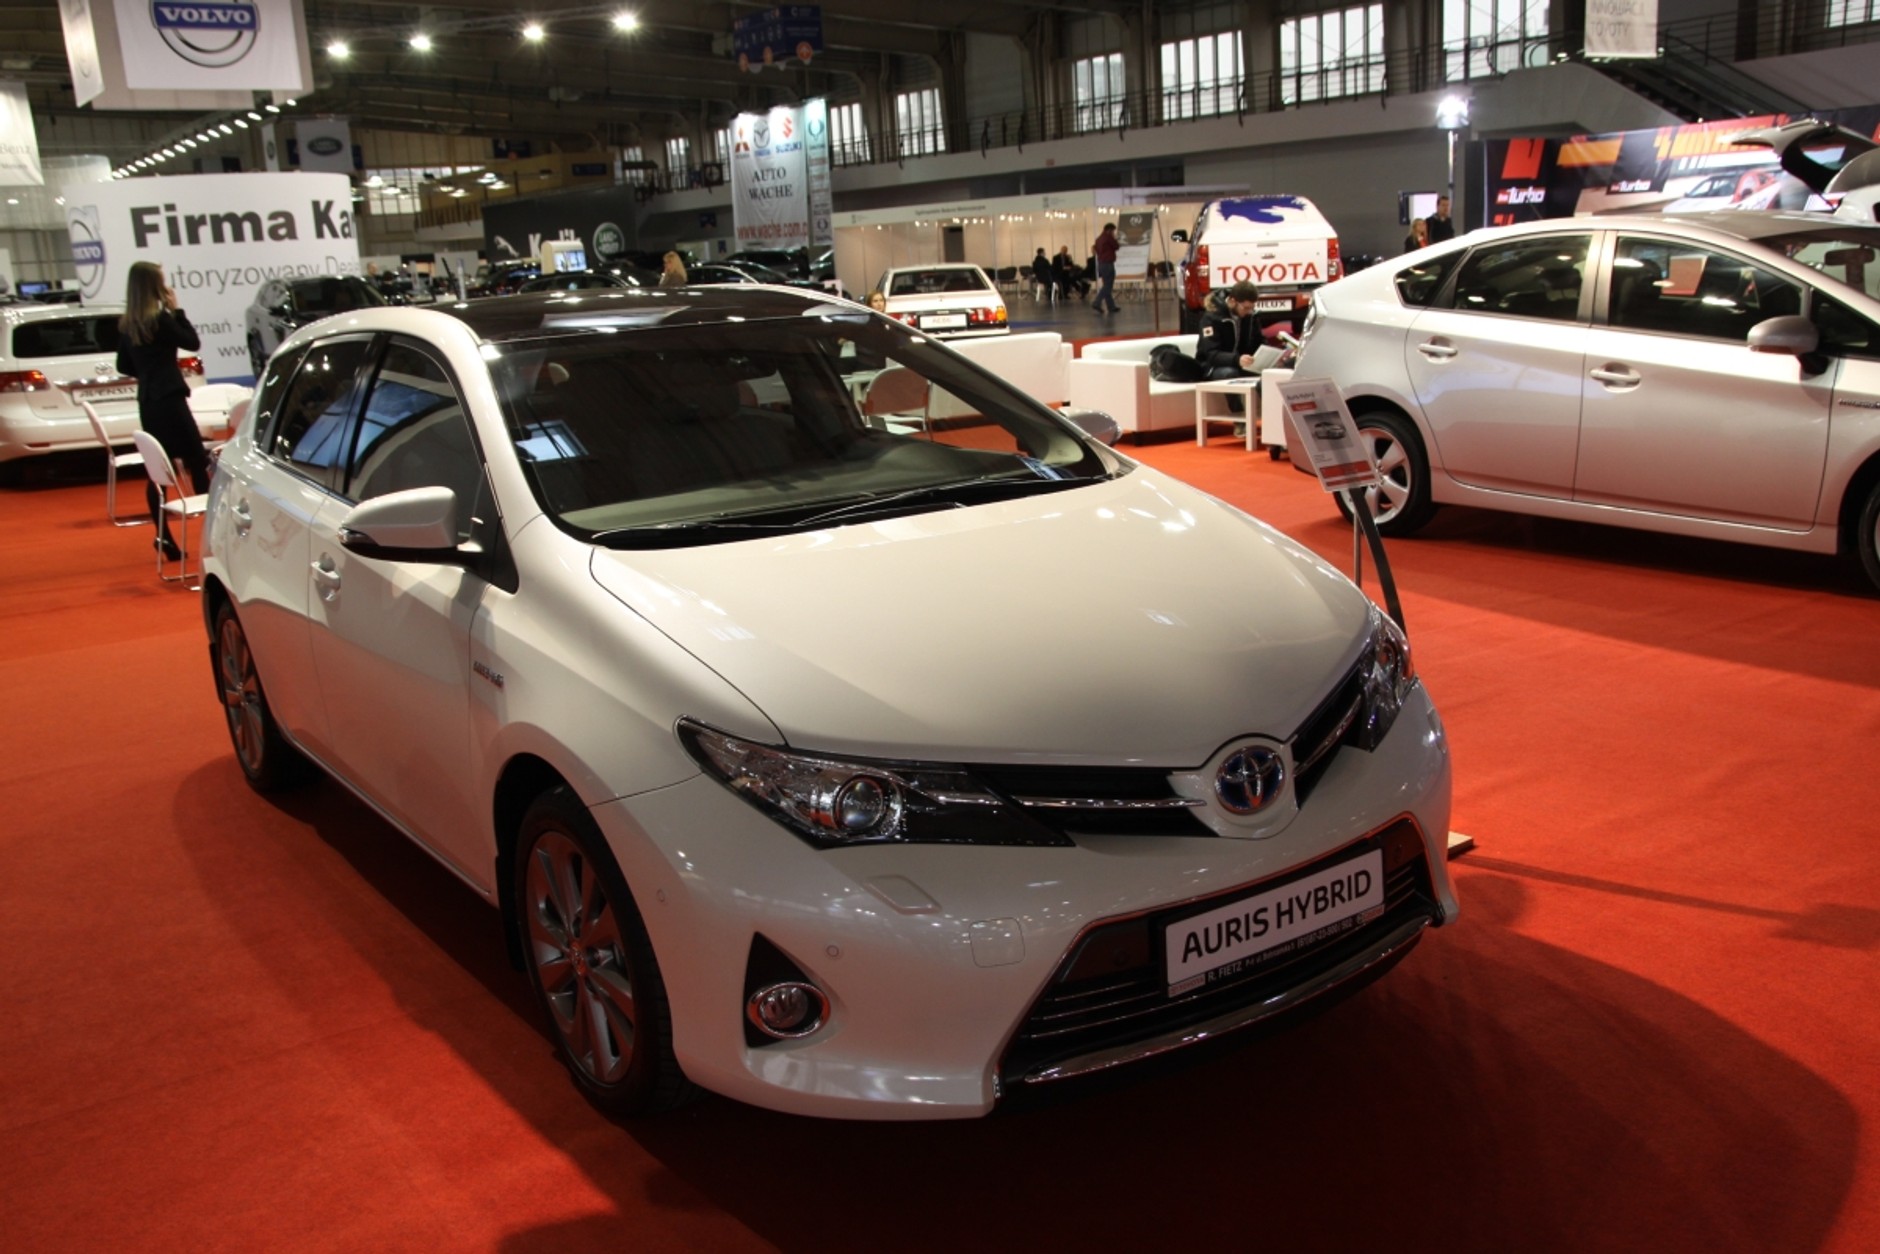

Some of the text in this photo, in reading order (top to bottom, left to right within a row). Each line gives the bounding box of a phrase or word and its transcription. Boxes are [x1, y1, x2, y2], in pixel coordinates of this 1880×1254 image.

[158, 6, 251, 24] VOLVO
[752, 167, 787, 183] AUTO
[749, 184, 793, 200] WACHE
[130, 203, 298, 248] Firma
[1217, 262, 1320, 284] TOYOTA
[1182, 907, 1269, 963] AURIS
[1276, 870, 1371, 929] HYBRID
